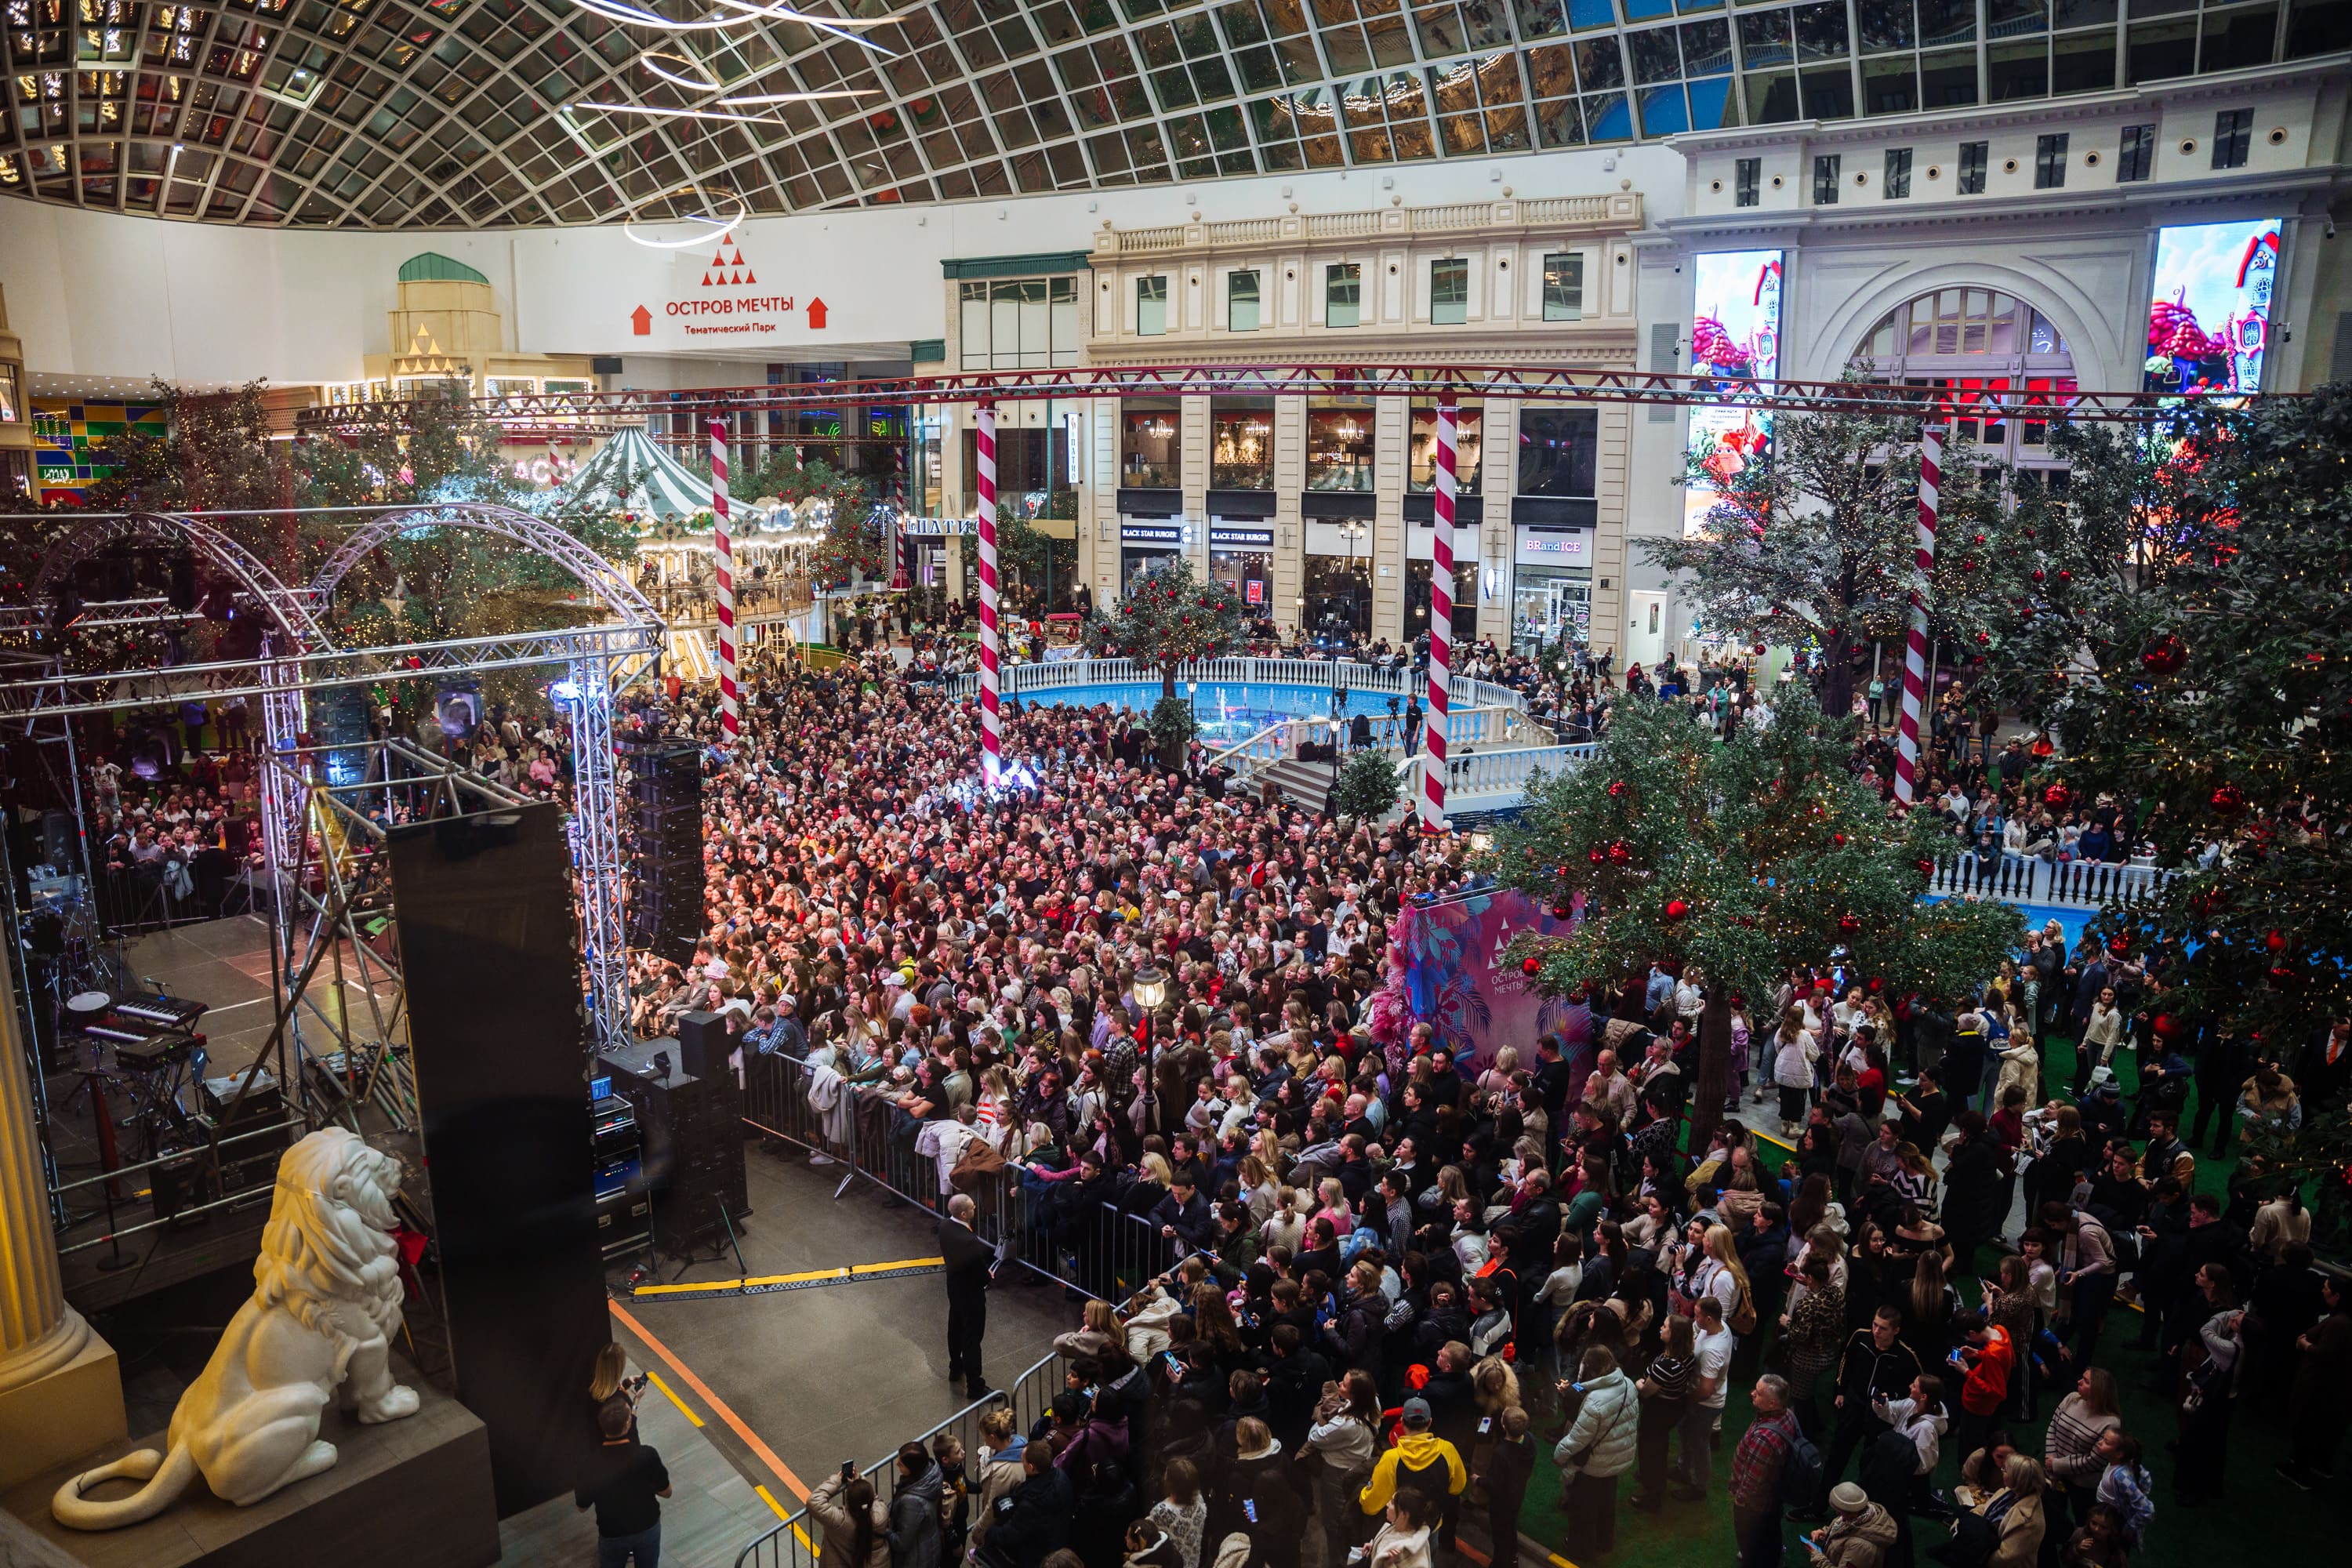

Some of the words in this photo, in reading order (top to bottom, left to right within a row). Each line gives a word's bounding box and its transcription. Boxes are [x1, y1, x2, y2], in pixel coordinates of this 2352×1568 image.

[666, 299, 732, 315] ОСТРОВ
[737, 296, 793, 313] МЕЧТЫ
[684, 324, 750, 334] Тематический
[752, 322, 775, 332] Парк
[1526, 540, 1581, 552] BRandICE
[1494, 980, 1523, 996] МЕЧТЫ
